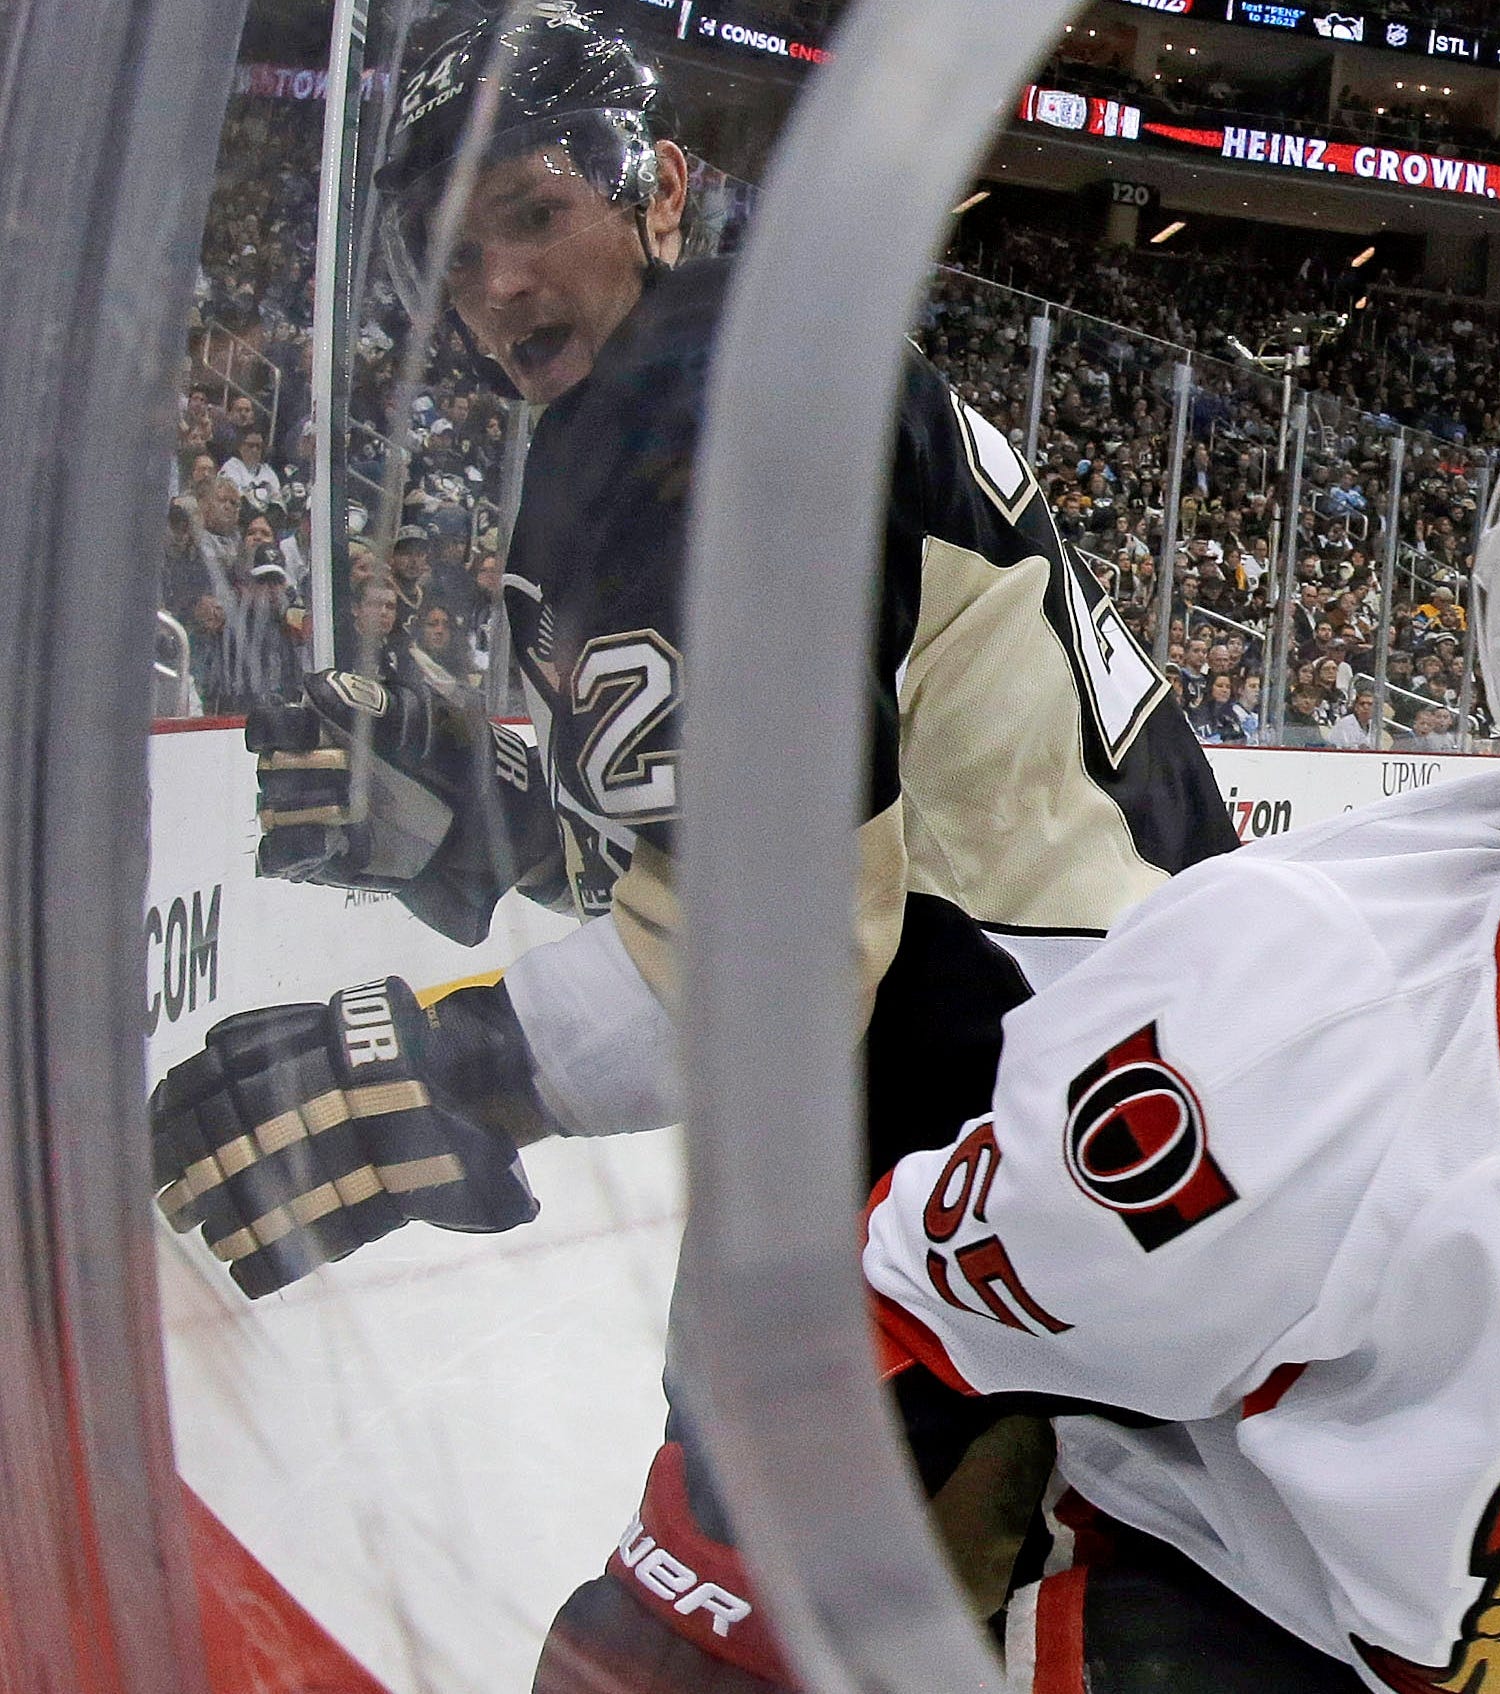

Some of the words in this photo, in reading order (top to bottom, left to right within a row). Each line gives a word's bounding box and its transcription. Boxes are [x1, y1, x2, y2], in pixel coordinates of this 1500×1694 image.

[721, 23, 789, 56] CONSOL
[1435, 35, 1469, 57] STL
[1221, 126, 1337, 173] HEINZ.
[1354, 146, 1496, 199] GROWN.
[1111, 182, 1150, 206] 120
[1223, 787, 1292, 841] izon
